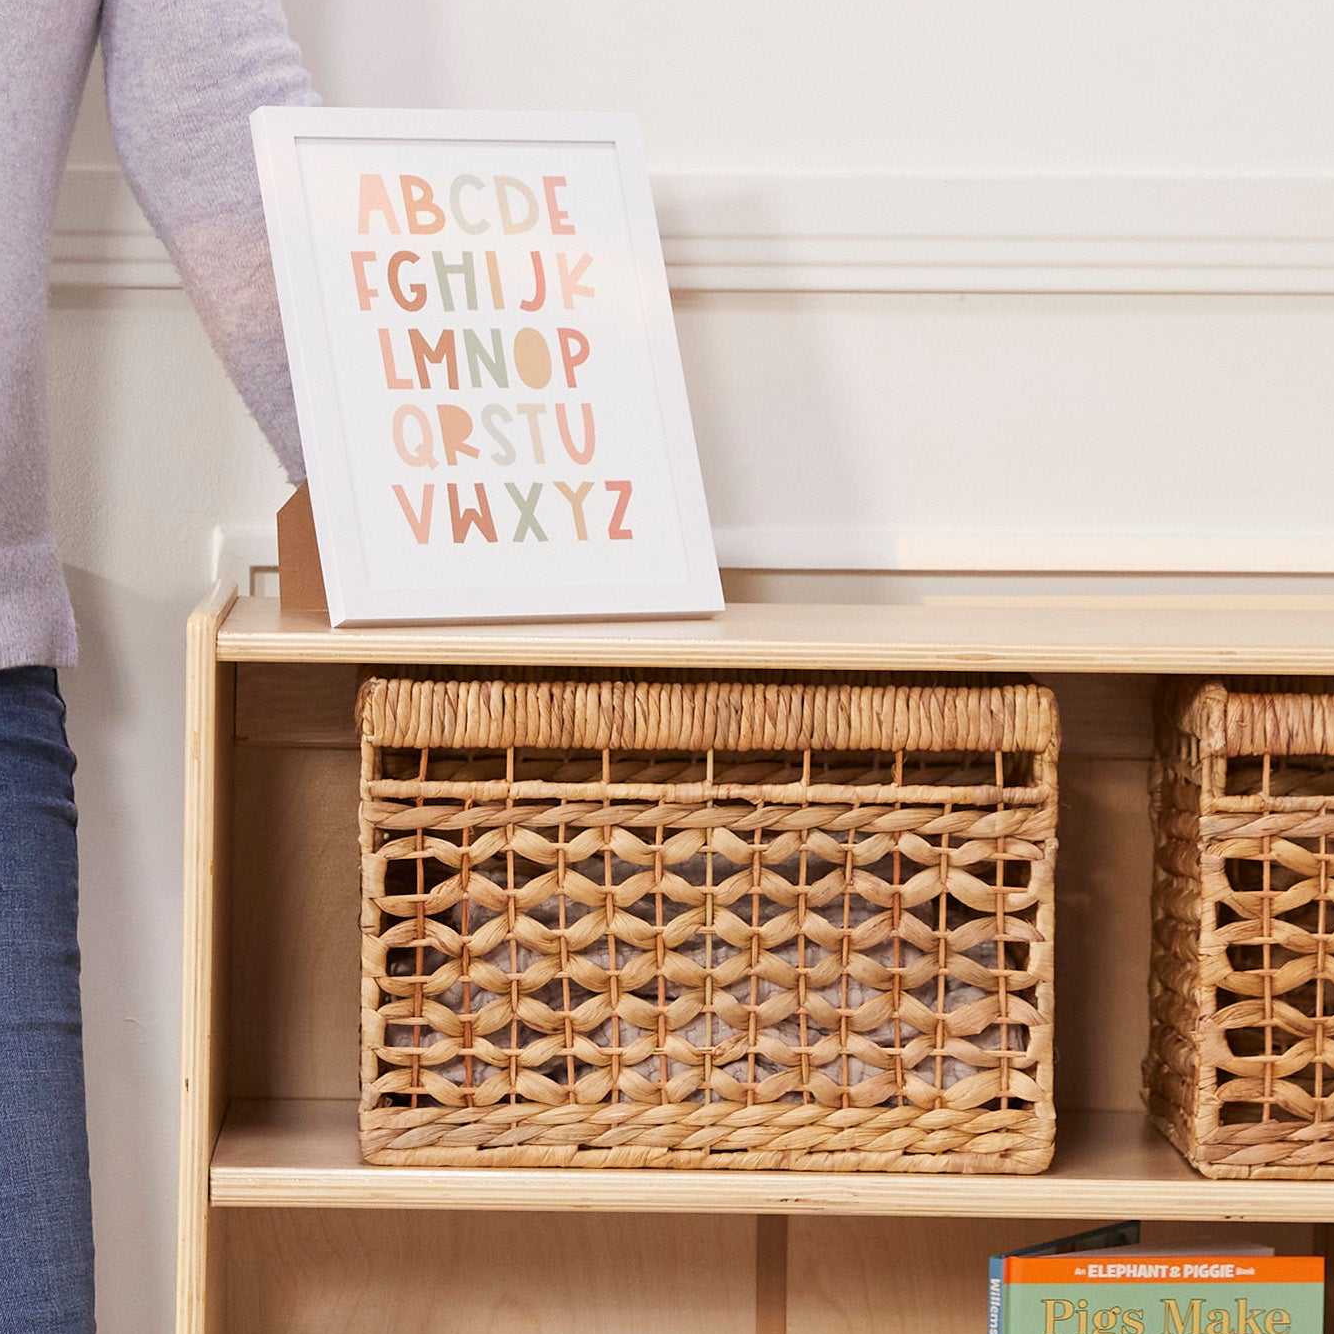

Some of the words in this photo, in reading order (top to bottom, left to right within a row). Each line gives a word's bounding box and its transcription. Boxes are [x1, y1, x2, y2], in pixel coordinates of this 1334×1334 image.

[358, 174, 576, 235] ABCDE
[350, 250, 595, 312] FGHIJK
[377, 326, 590, 390] LMNOP
[392, 403, 596, 469] QRSTU
[391, 480, 633, 544] VWXYZ
[1087, 1264, 1169, 1278] ELEPHANT
[1169, 1266, 1180, 1278] &
[1183, 1264, 1235, 1278] PIGGIE
